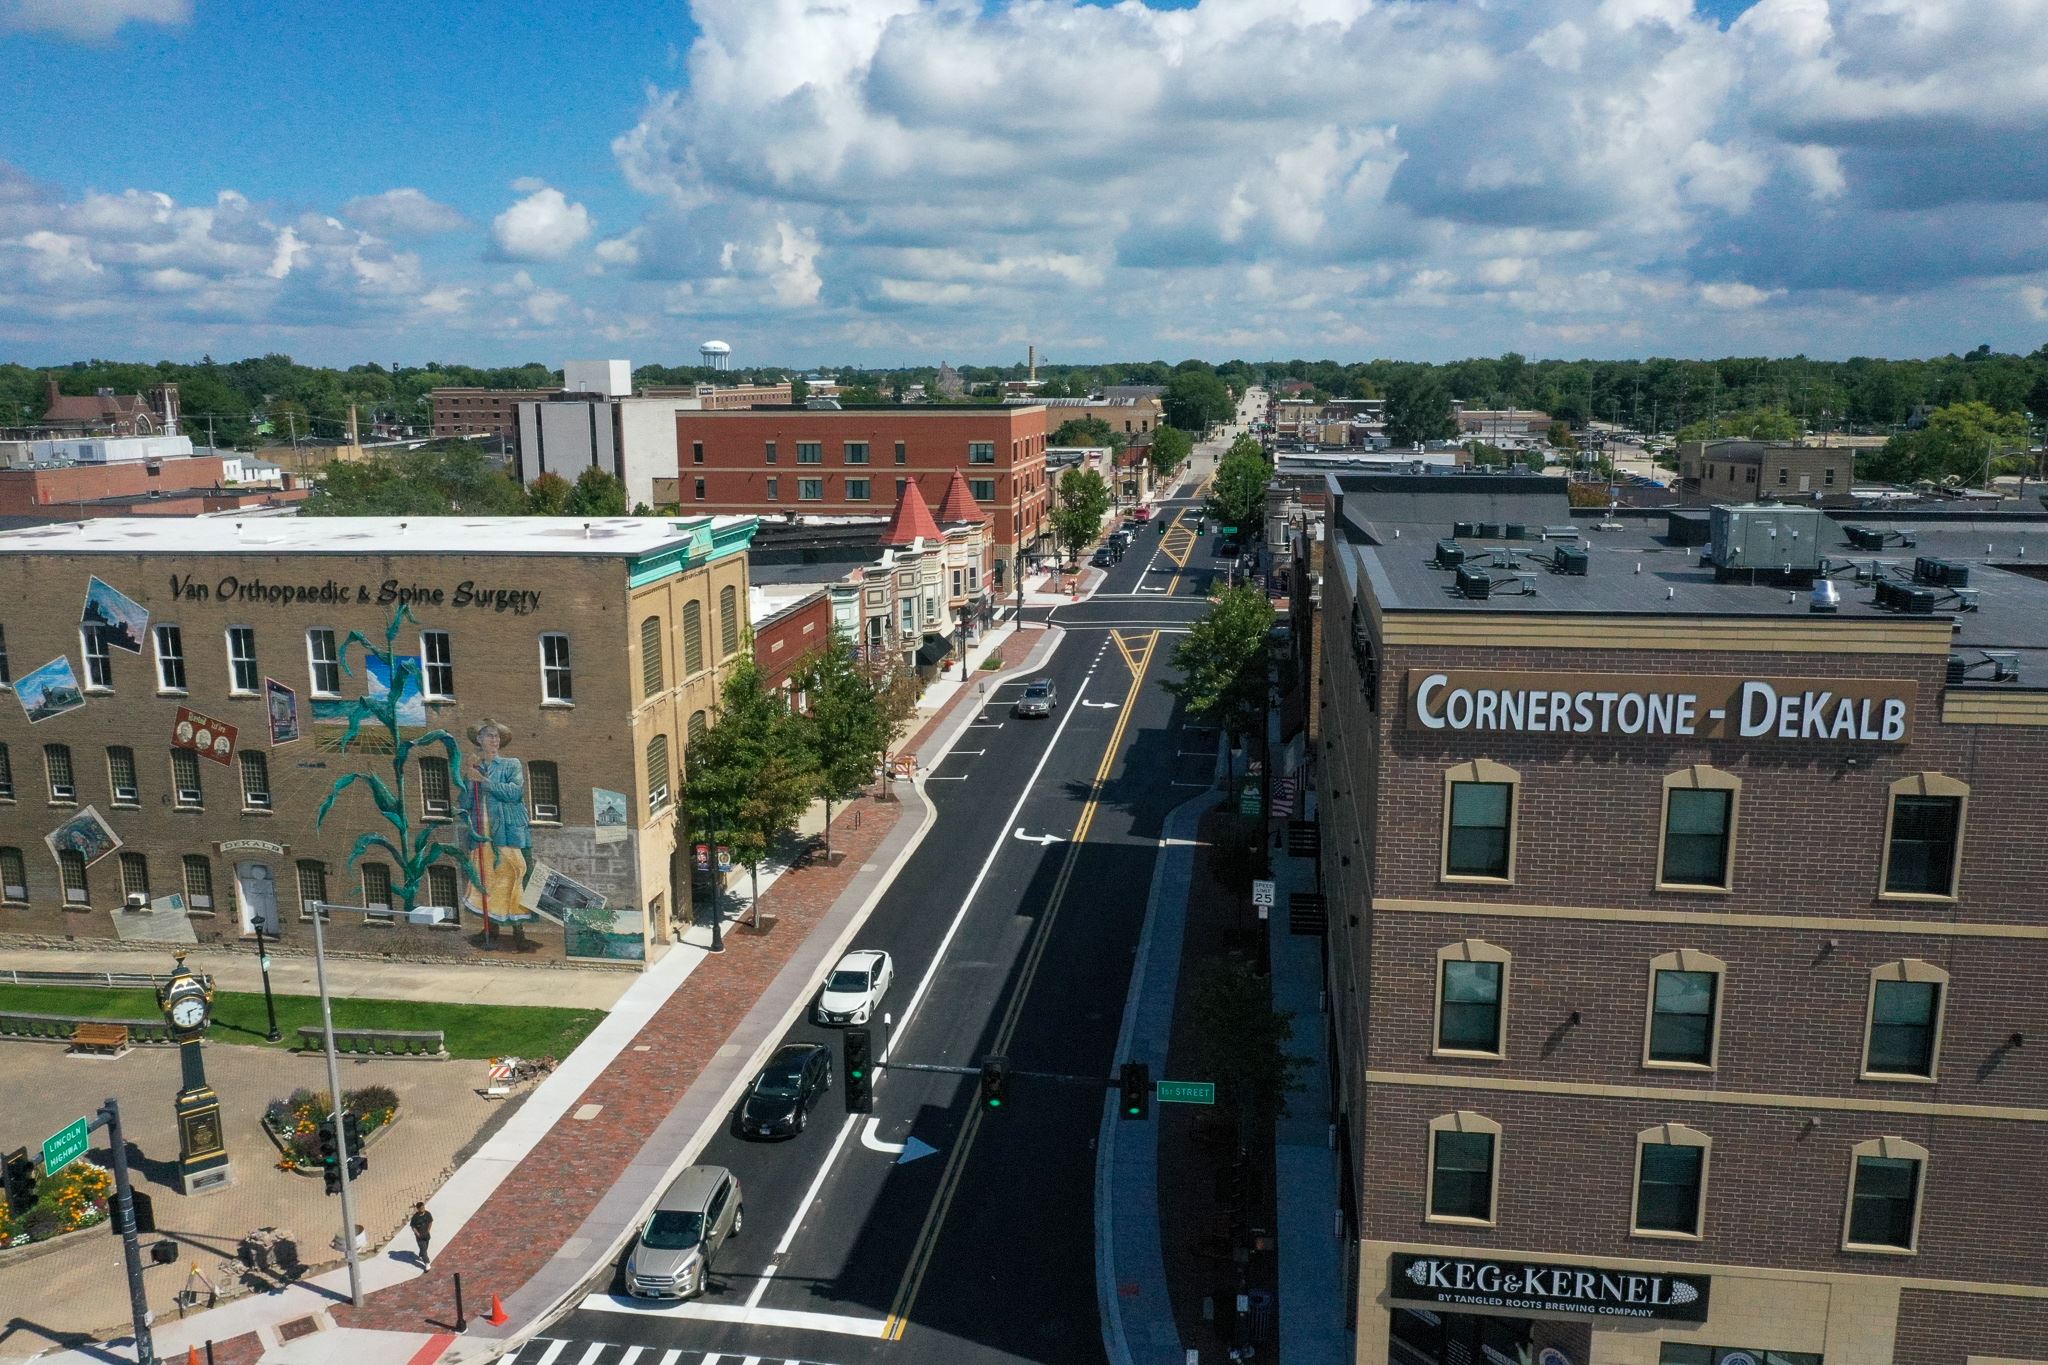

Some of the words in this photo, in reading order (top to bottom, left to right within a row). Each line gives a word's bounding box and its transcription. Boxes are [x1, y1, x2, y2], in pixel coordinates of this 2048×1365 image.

[170, 574, 209, 601] Van
[216, 576, 350, 607] Orthopaedic
[357, 585, 371, 604] &
[377, 579, 445, 605] Spine
[451, 580, 542, 613] Surgery
[1255, 893, 1272, 904] 25
[1175, 1087, 1210, 1097] STREET
[49, 1126, 81, 1153] LINCOLN
[50, 1139, 83, 1168] HIGHWAY
[1438, 1293, 1451, 1302] BY
[1454, 1294, 1503, 1306] TANGLED
[1505, 1298, 1542, 1309] ROOTS
[1545, 1302, 1595, 1313] BREWING
[1599, 1305, 1654, 1318] COMPANY
